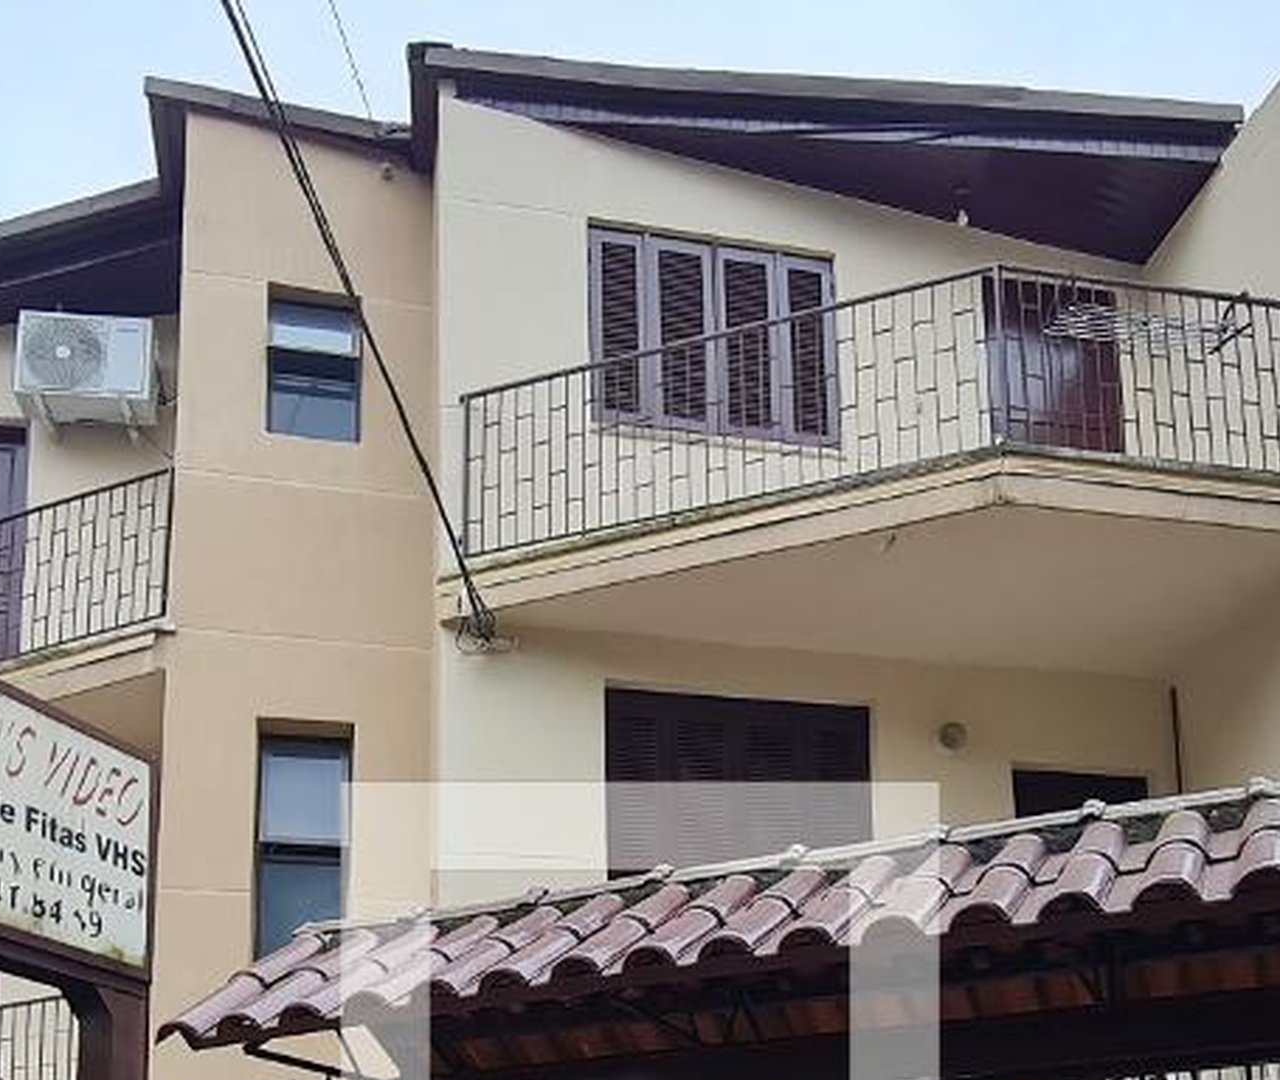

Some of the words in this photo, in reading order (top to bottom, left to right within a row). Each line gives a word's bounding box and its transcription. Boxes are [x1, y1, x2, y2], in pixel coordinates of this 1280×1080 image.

[44, 741, 144, 827] VIDEO
[25, 804, 88, 854] Fitas
[95, 832, 147, 878] VHS
